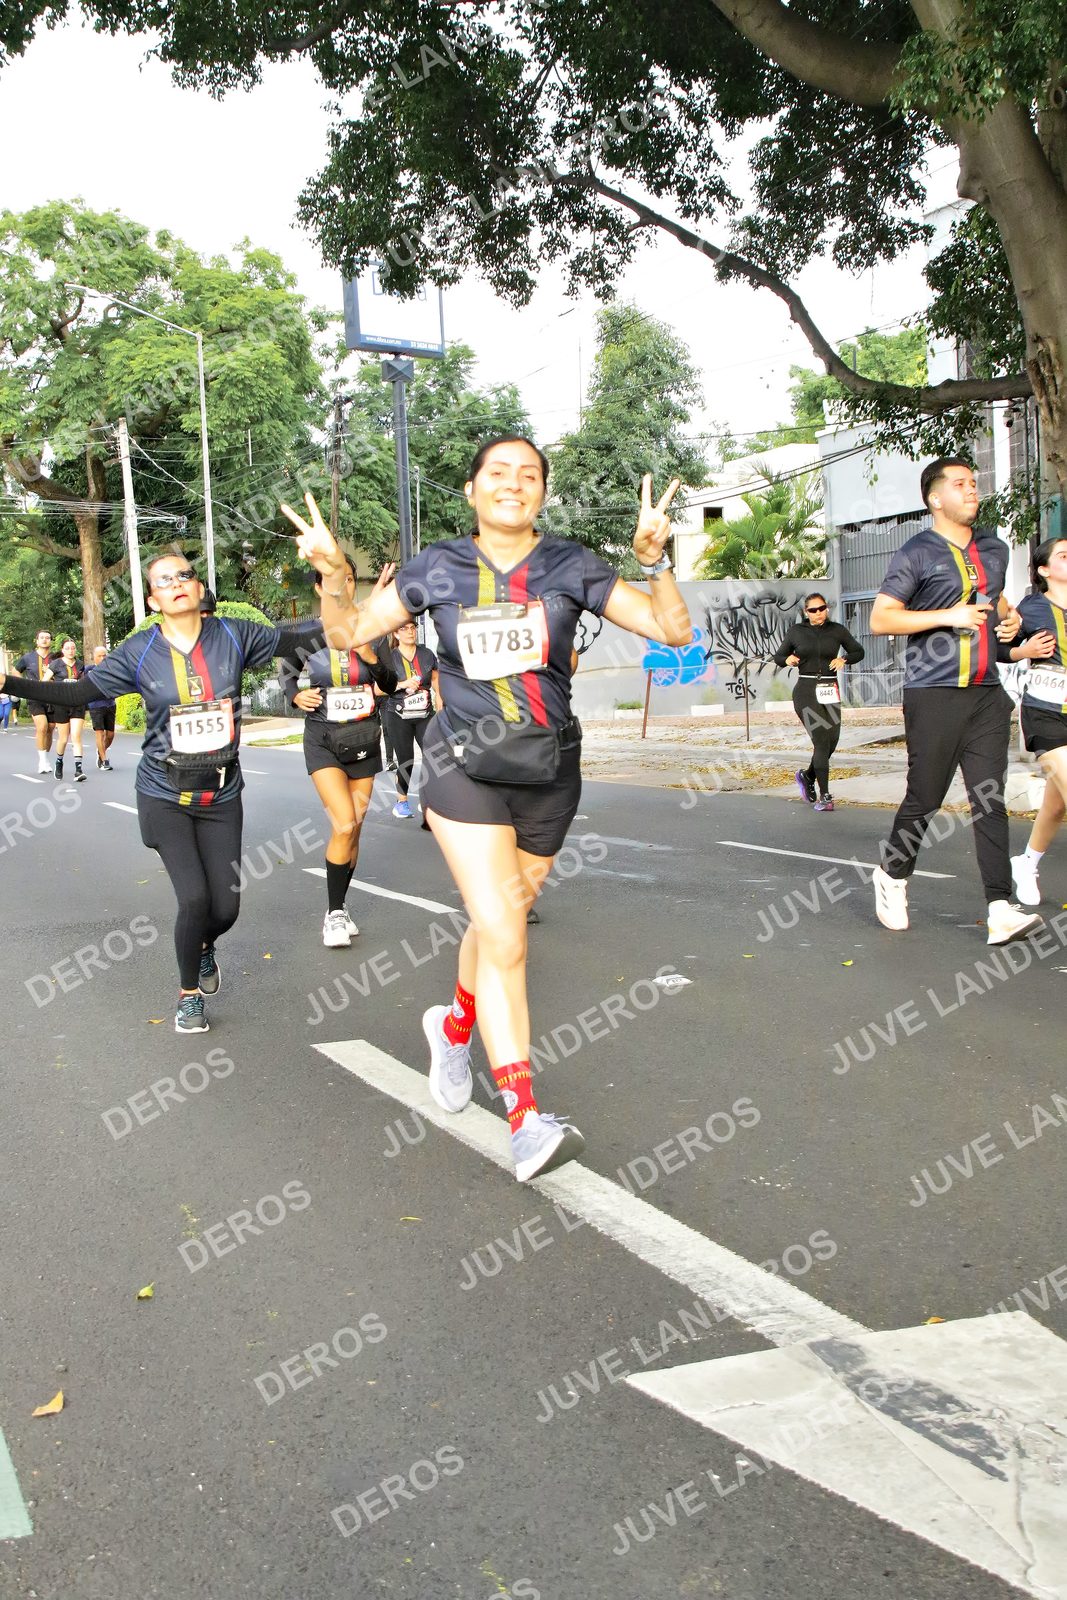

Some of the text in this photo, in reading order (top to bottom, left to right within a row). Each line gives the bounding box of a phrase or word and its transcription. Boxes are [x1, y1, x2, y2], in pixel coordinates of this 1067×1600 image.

[463, 628, 534, 654] 11783
[1029, 673, 1065, 690] 10464
[334, 698, 364, 710] 9623
[175, 717, 225, 736] 11555
